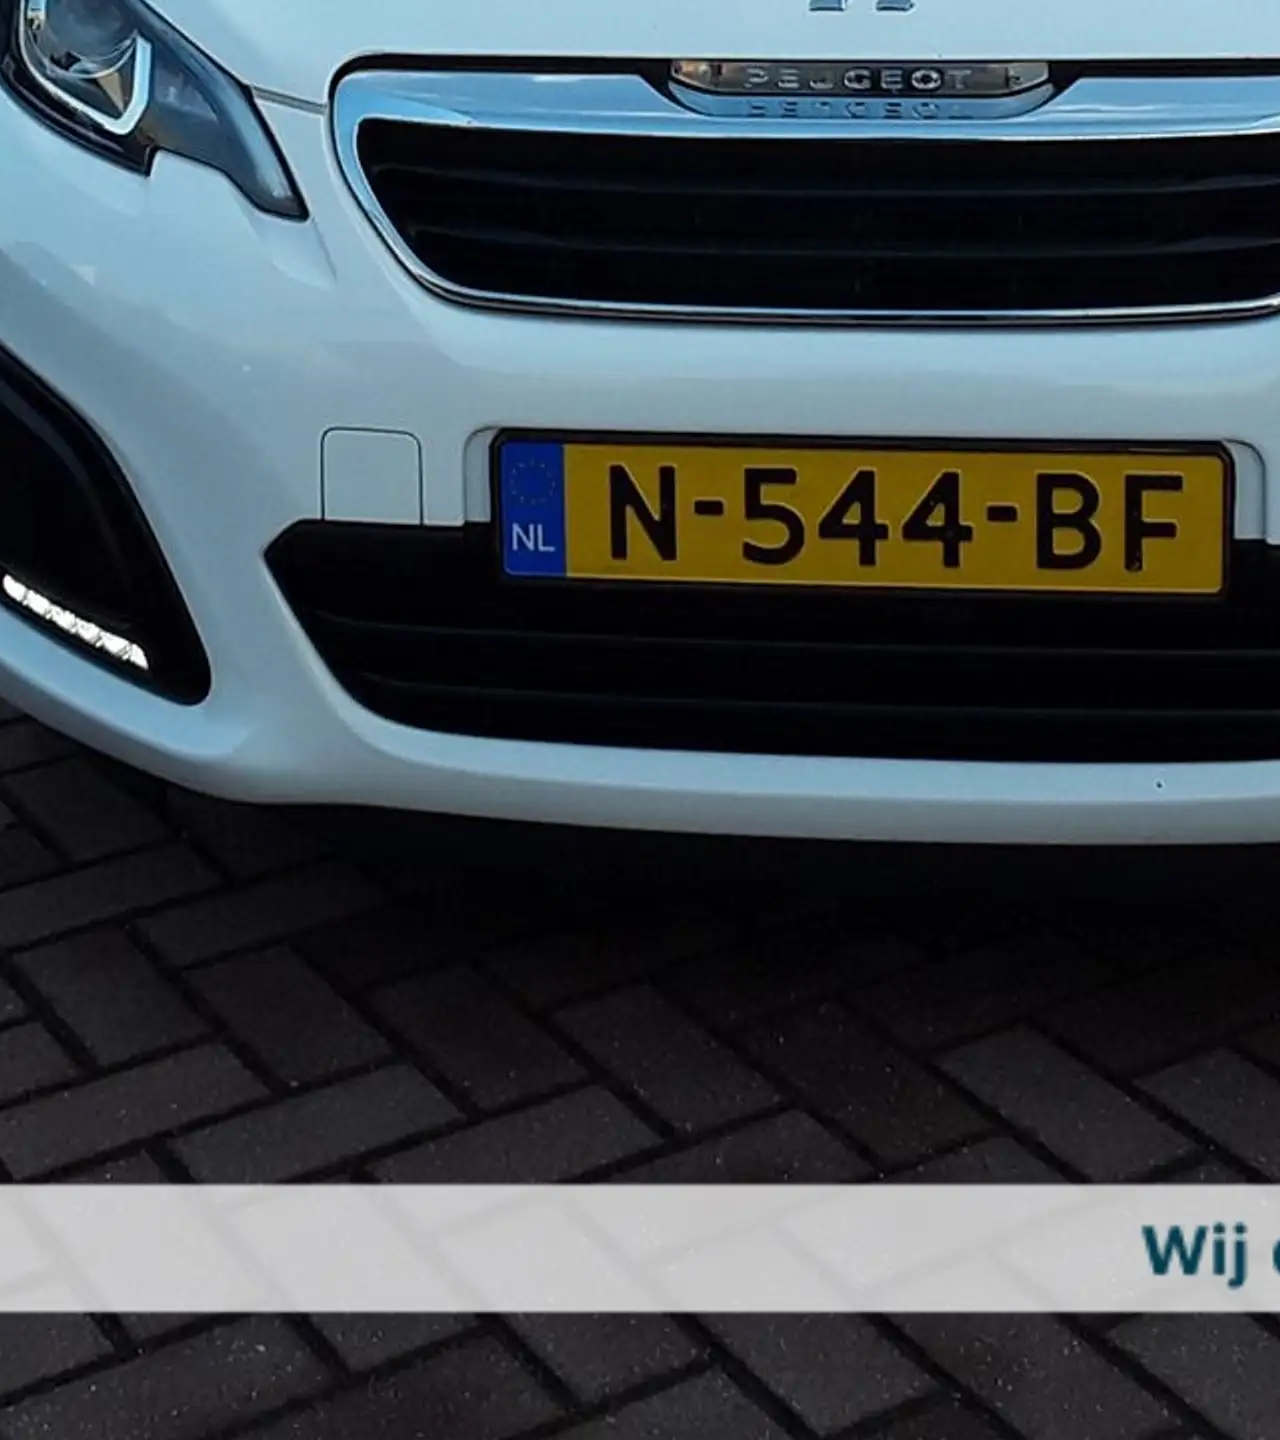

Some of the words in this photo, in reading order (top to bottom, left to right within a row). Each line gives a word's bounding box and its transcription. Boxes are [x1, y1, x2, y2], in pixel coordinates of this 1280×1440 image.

[744, 66, 973, 91] PEUGEOT
[511, 523, 556, 552] NL
[608, 463, 1184, 572] N-544-BF
